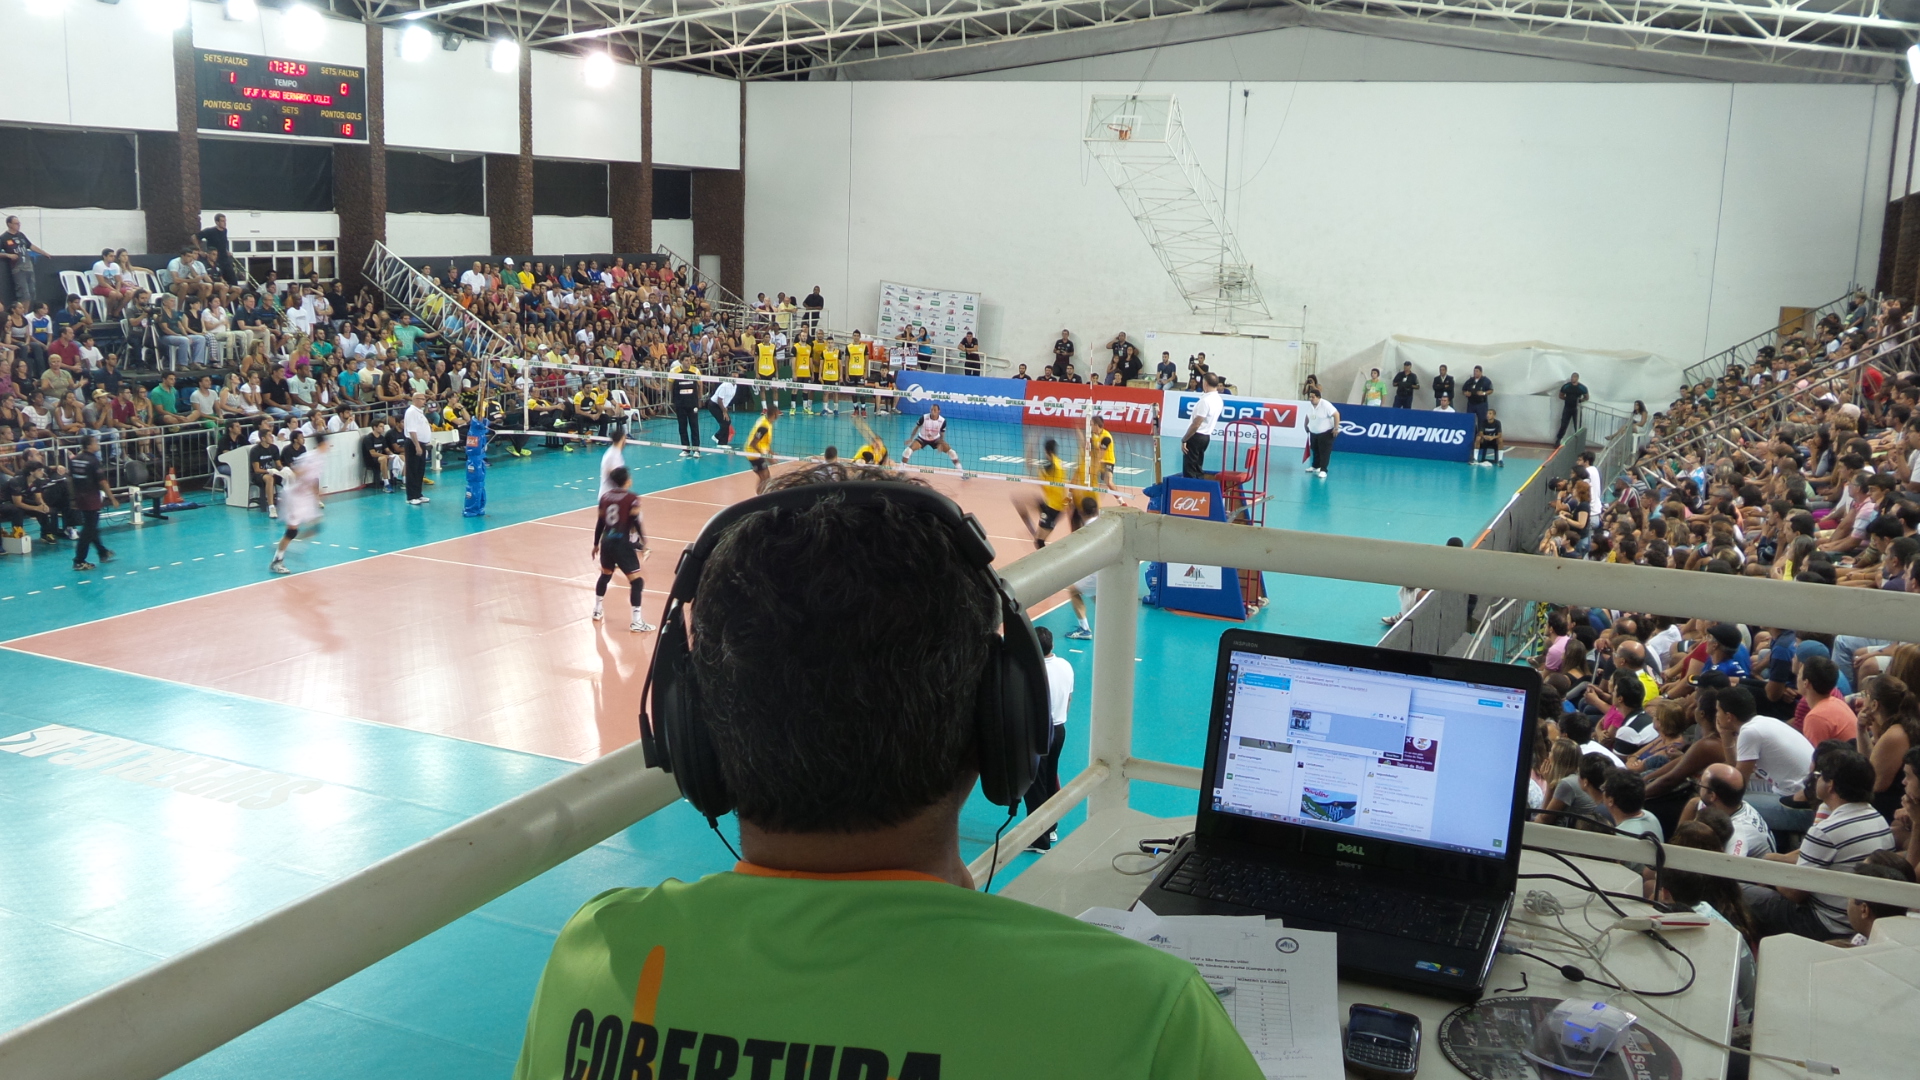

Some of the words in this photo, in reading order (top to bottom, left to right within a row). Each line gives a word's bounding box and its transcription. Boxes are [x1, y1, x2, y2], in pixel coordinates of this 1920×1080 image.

[203, 53, 249, 66] SETS/FALTAS
[320, 66, 359, 78] SETS/FALTAS
[274, 78, 298, 88] TEMPO
[243, 87, 260, 97] UFJF
[282, 92, 312, 103] BERNARDO
[203, 99, 251, 111] PONTOS/GOLS
[281, 105, 299, 114] SETS
[320, 109, 362, 120] PONTOS/GOLS
[228, 114, 240, 129] 12
[284, 118, 293, 131] 2
[1186, 402, 1291, 423] SORTV
[1367, 421, 1467, 445] OLYMPIKUS
[605, 503, 620, 526] 8
[1336, 842, 1365, 856] DELL
